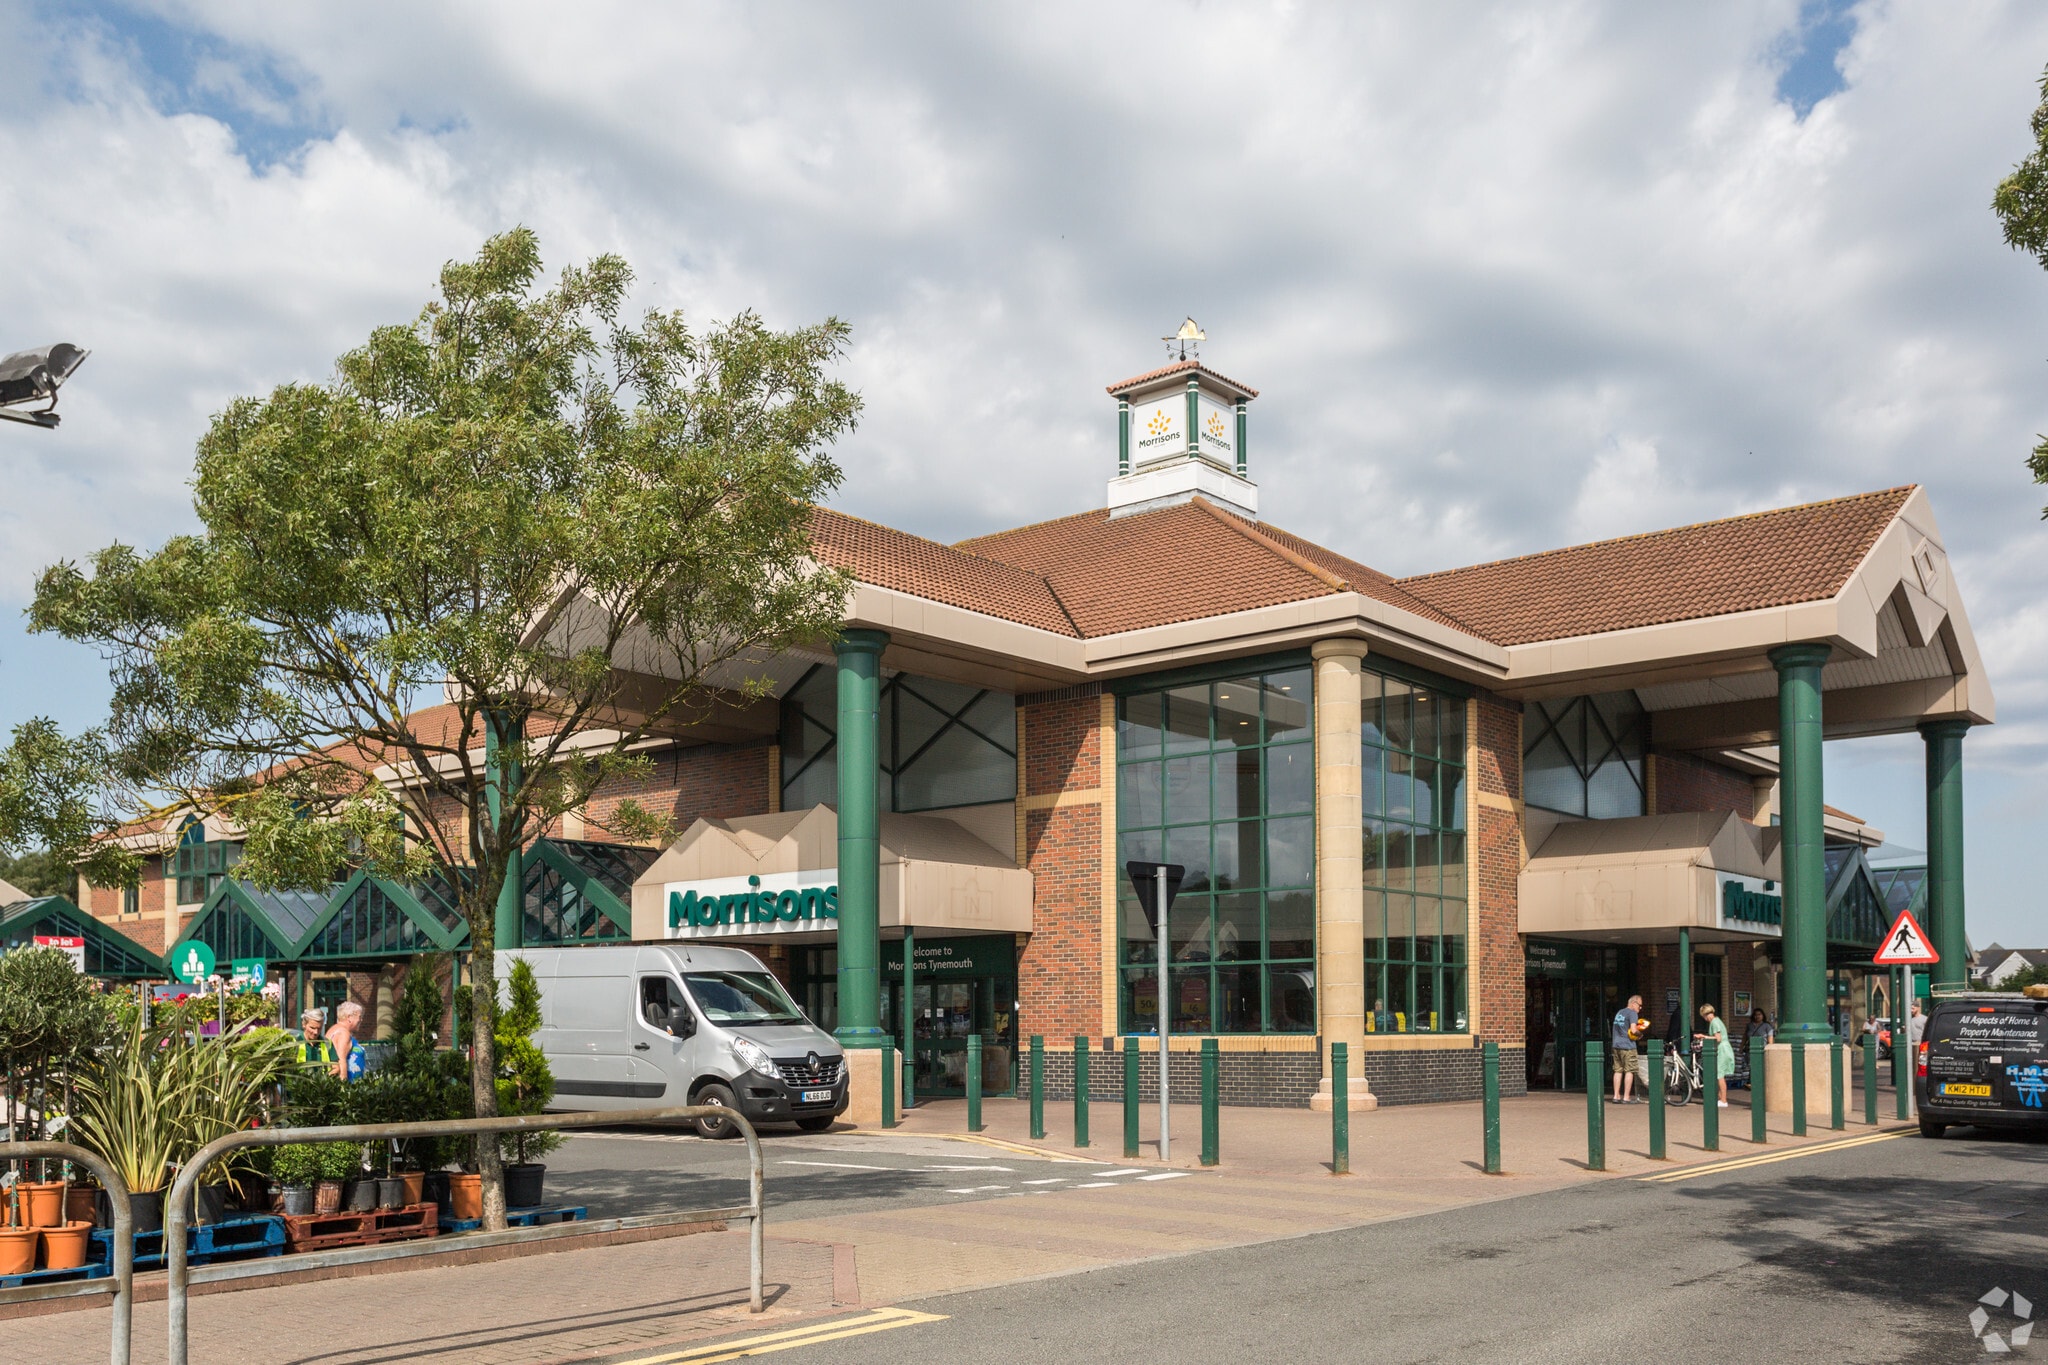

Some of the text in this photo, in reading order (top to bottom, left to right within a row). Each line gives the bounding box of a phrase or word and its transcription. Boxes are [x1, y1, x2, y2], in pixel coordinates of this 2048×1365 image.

[1138, 432, 1181, 448] Morrisons
[1201, 431, 1231, 451] Morrisons
[669, 875, 837, 928] Morrisons
[60, 938, 74, 946] let
[913, 946, 953, 957] elcome to
[888, 957, 973, 972] Morons Tynemouth
[1959, 1015, 1971, 1024] All
[1970, 1015, 1998, 1027] Aspects
[2008, 1016, 2031, 1026] Home
[2031, 1016, 2039, 1026] &
[1960, 1027, 2038, 1038] Property Maintenance
[1969, 1086, 1988, 1095] HTU
